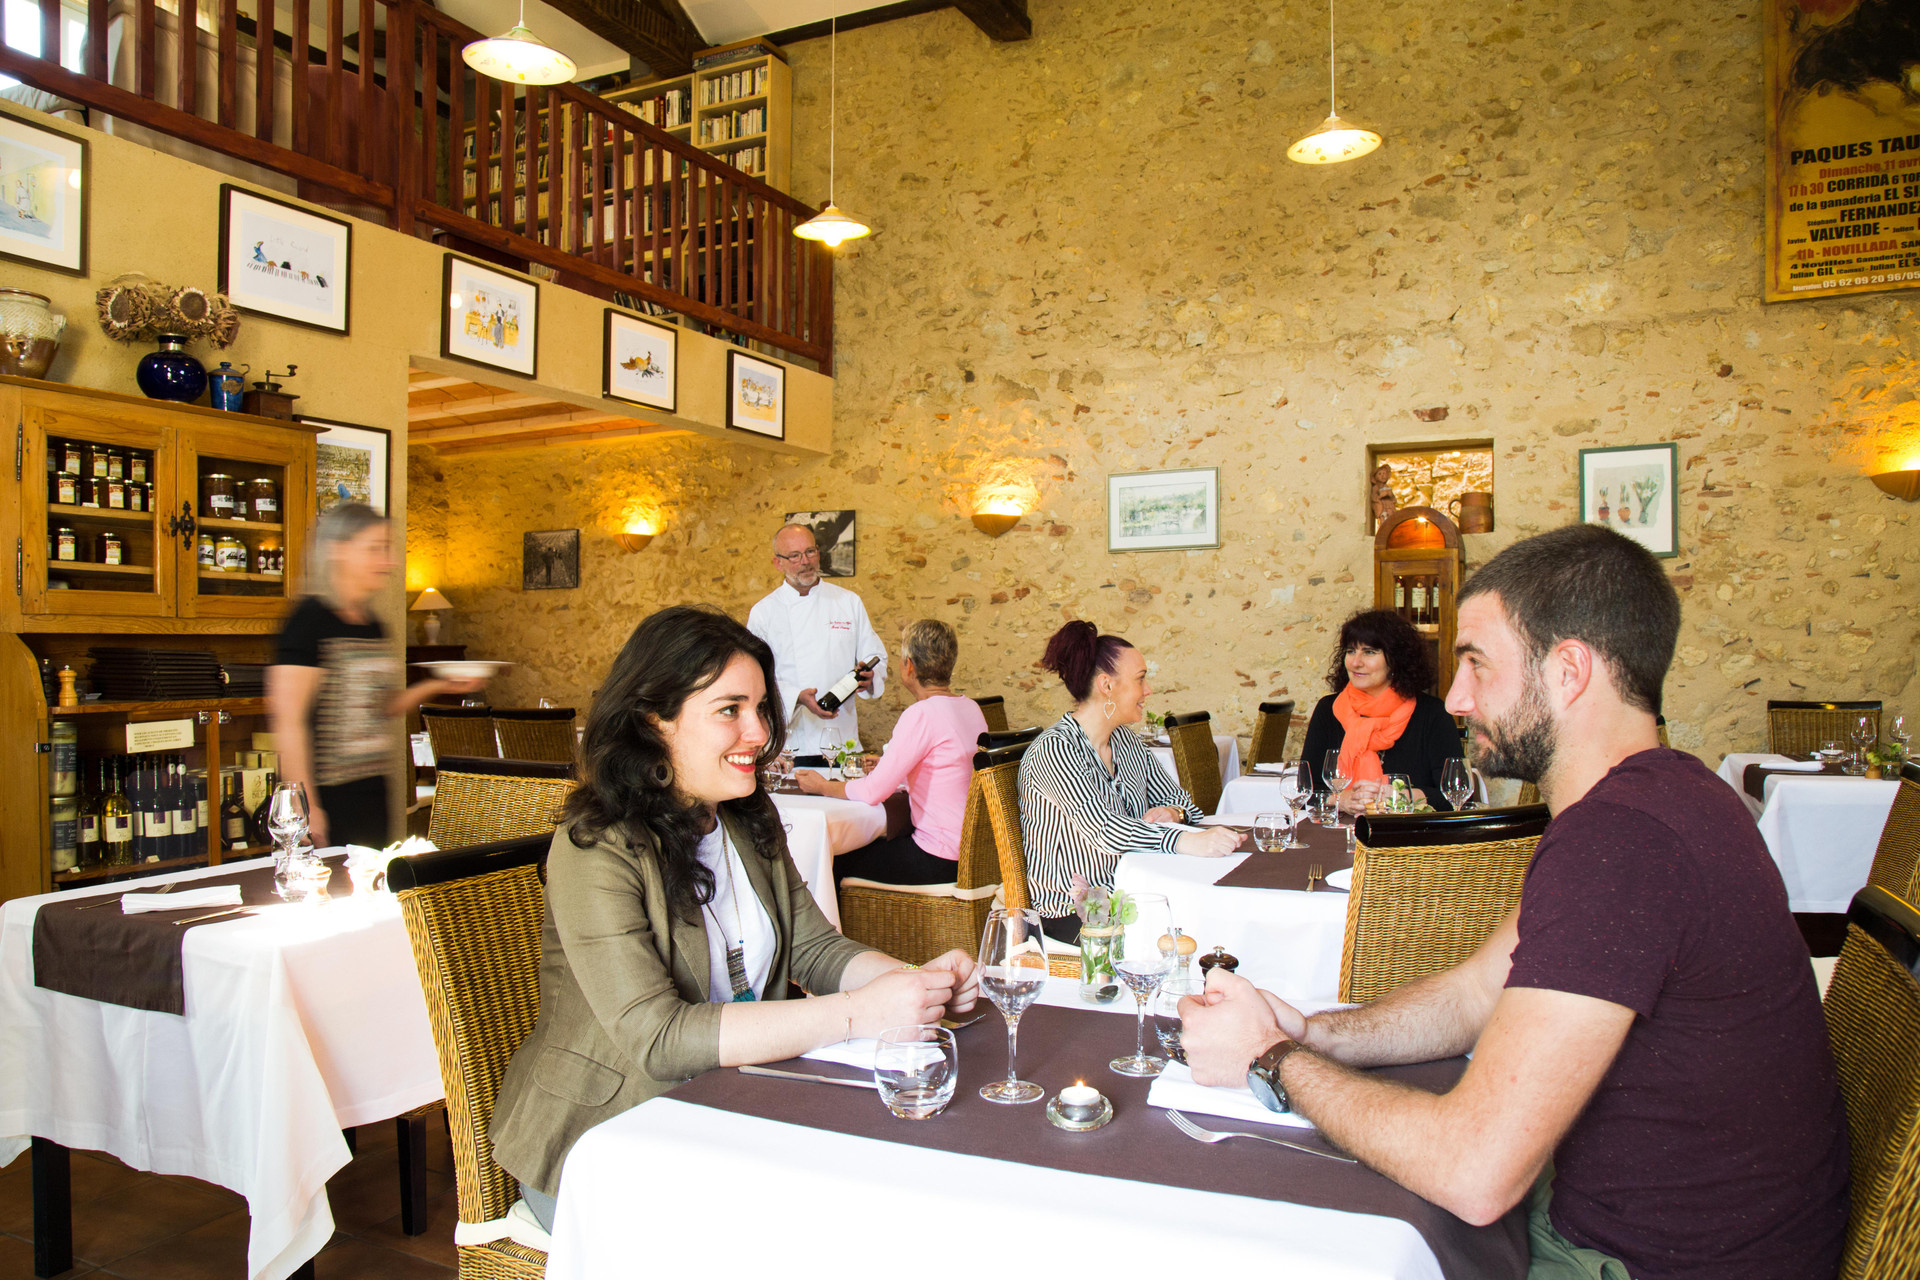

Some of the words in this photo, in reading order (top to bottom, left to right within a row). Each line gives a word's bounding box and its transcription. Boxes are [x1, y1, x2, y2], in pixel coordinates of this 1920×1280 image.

[1791, 142, 1872, 165] PAQUES
[1819, 163, 1880, 179] Dimanche
[1884, 160, 1895, 170] 11
[1788, 185, 1798, 197] 17
[1800, 184, 1807, 196] h
[1810, 182, 1823, 195] 30
[1827, 174, 1889, 192] CORRIDA
[1892, 175, 1899, 184] 6
[1790, 202, 1803, 212] de
[1807, 200, 1817, 210] la
[1884, 188, 1899, 200] EL
[1810, 222, 1880, 242] VALVERDE
[1822, 240, 1898, 257] NOVILLADA
[1801, 259, 1853, 268] Novillos
[1817, 267, 1834, 276] GIL
[1871, 263, 1896, 271] Julian
[1899, 258, 1910, 268] EL
[1823, 280, 1836, 288] 05
[1839, 278, 1852, 286] 62
[1855, 276, 1869, 285] 09
[1871, 274, 1885, 283] 20
